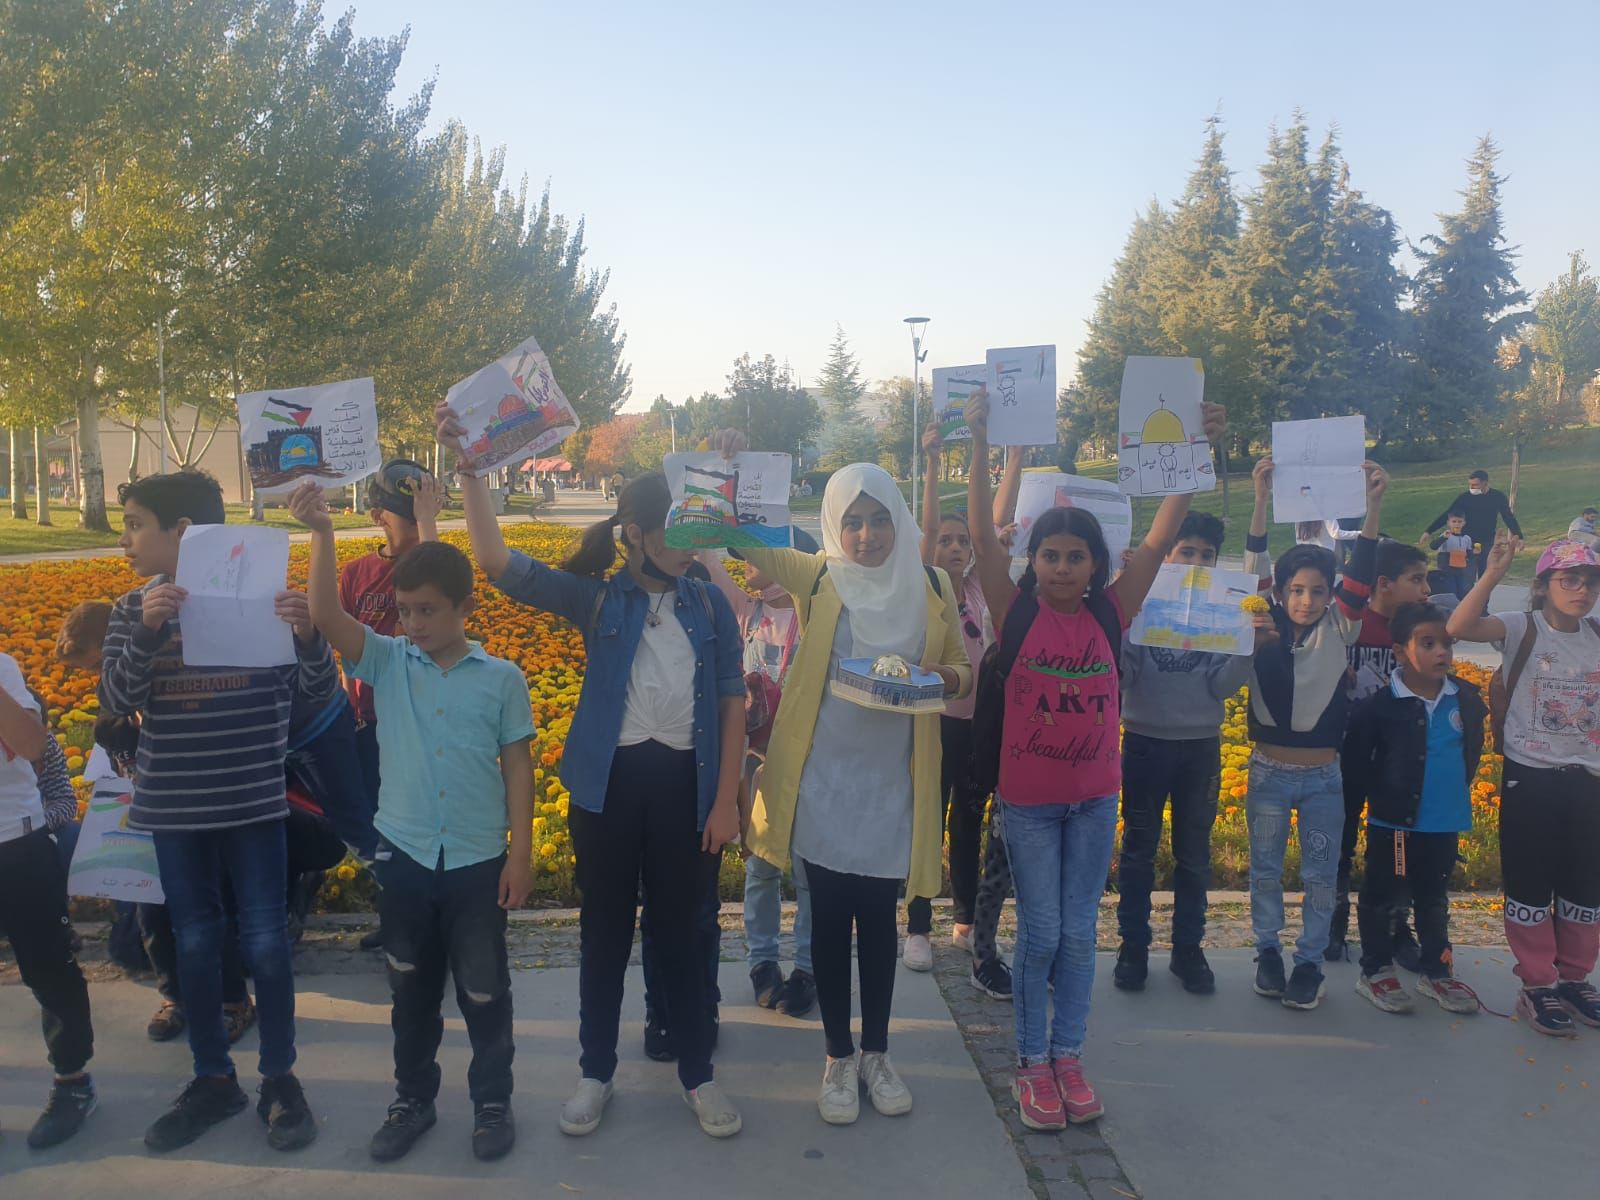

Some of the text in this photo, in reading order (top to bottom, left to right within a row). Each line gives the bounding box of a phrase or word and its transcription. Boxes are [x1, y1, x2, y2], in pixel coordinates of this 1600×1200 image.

[1036, 638, 1102, 674] smile
[1026, 729, 1104, 768] beautiful
[1506, 902, 1548, 923] GOO
